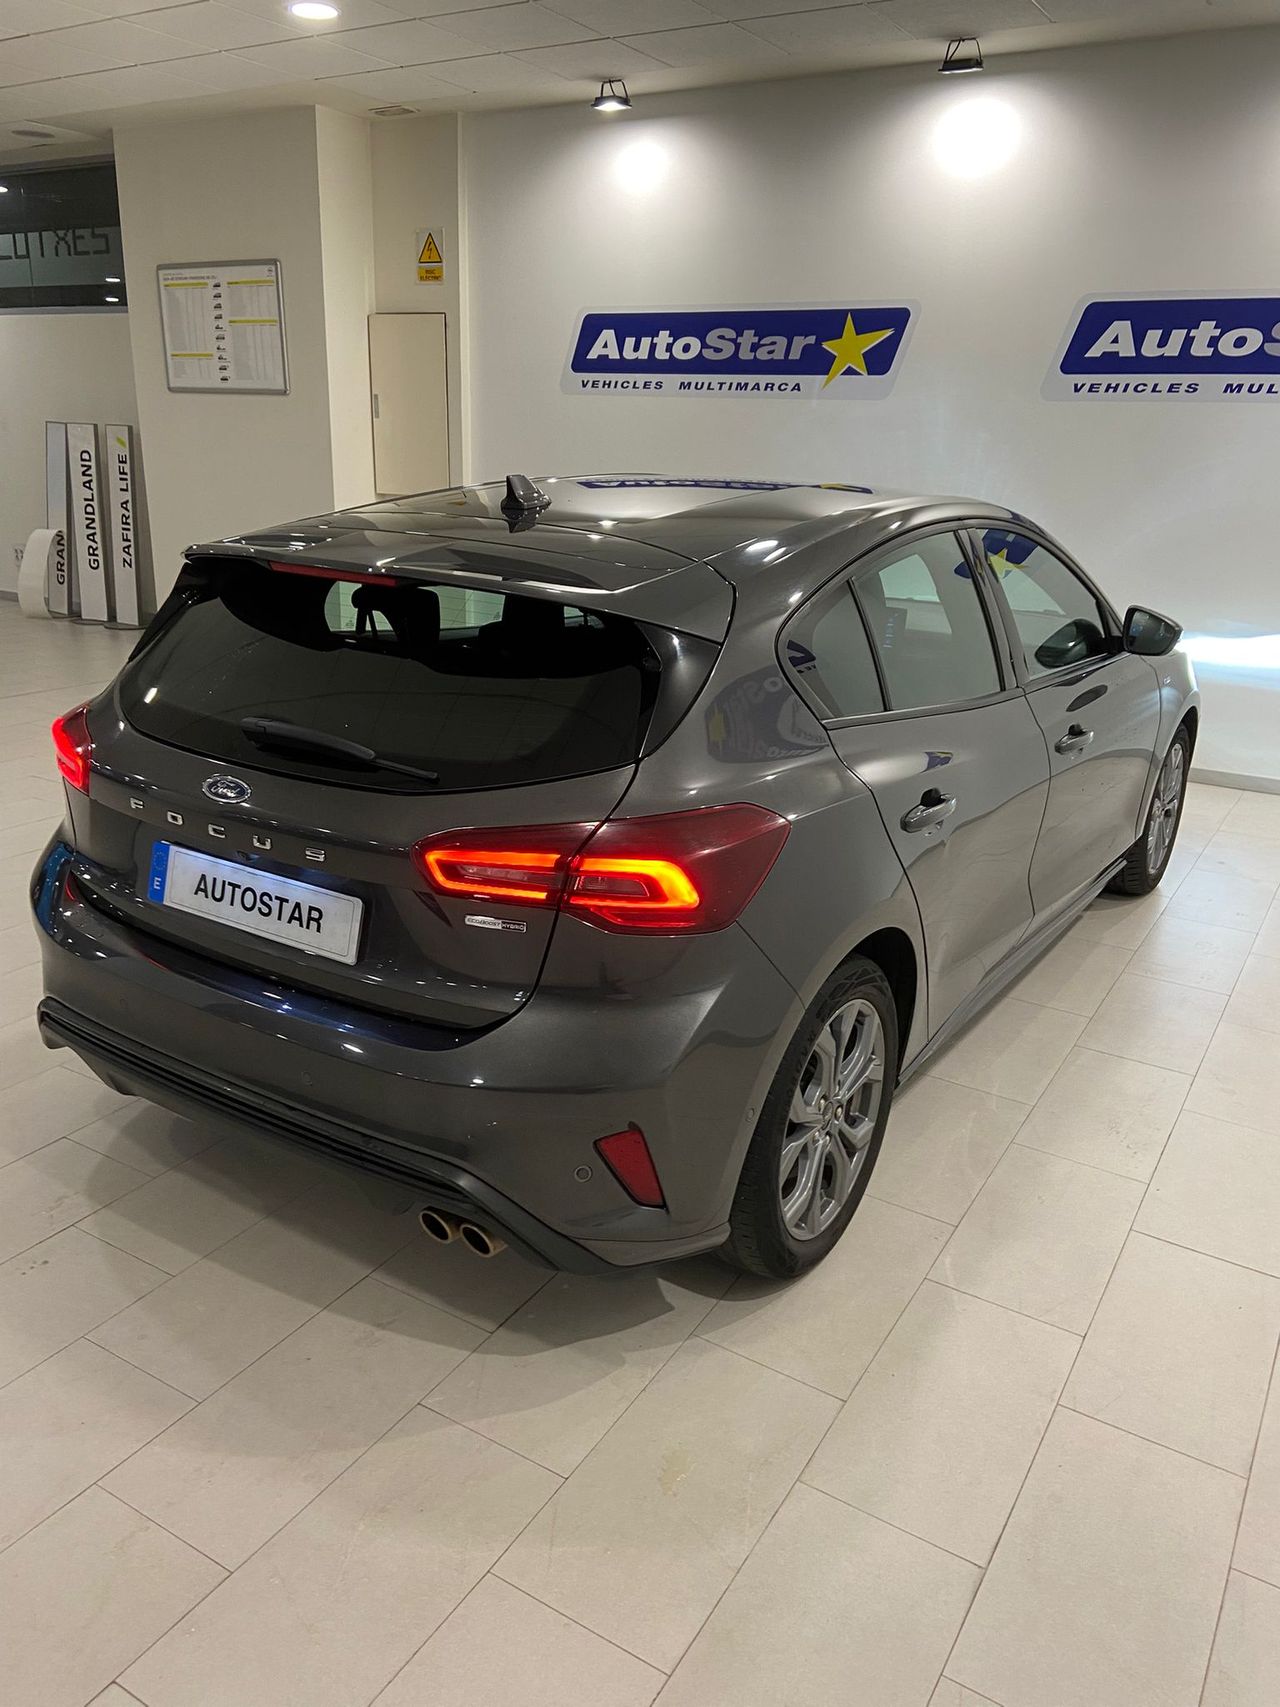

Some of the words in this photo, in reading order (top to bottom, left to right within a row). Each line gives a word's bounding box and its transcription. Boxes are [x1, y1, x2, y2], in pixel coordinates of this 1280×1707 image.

[0, 226, 110, 260] OTXES
[586, 328, 816, 360] AutoStar
[581, 379, 664, 390] VEHICLES
[678, 381, 801, 392] MULTIMARCA
[1073, 382, 1200, 394] VEHICLES
[118, 453, 129, 492] LIFE
[80, 450, 100, 571] GRANDLAND
[120, 499, 134, 569] ZAFIRA
[130, 797, 326, 862] FOCUS
[153, 877, 161, 890] E
[194, 873, 324, 934] AUTOSTAR
